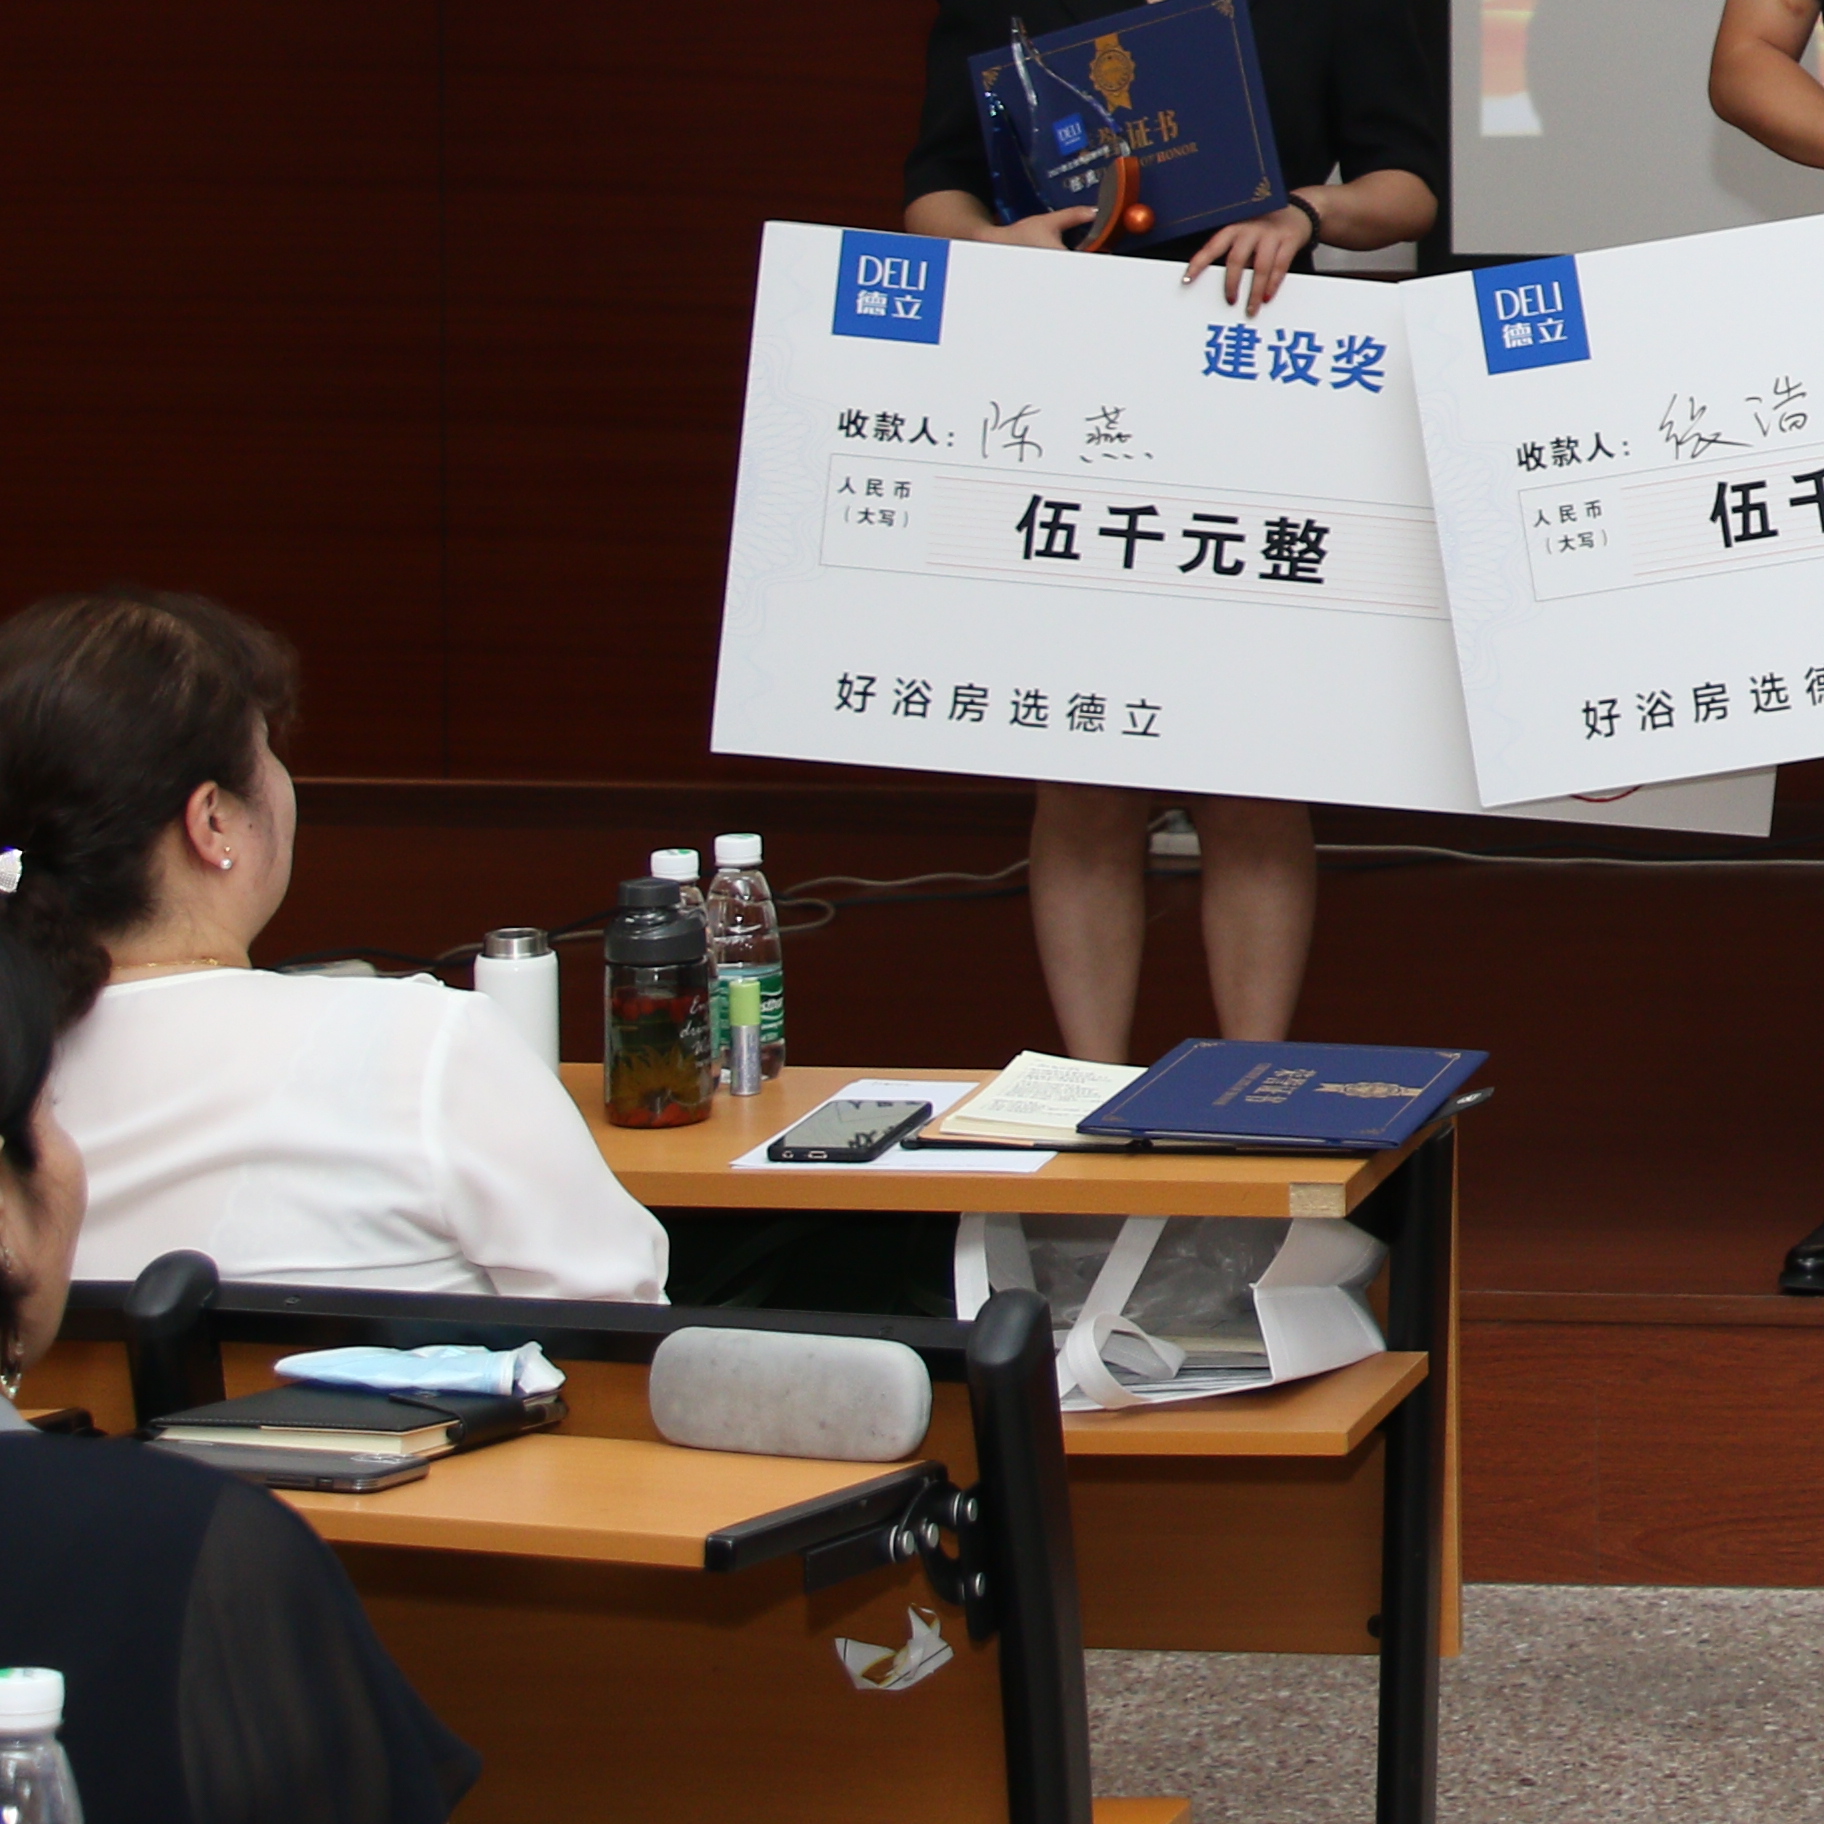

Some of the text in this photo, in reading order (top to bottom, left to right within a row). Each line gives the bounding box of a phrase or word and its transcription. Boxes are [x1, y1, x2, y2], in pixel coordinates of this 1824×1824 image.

[858, 255, 928, 290] DELI
[856, 290, 922, 321] 德立
[1494, 280, 1563, 321] DELI
[1502, 317, 1568, 349] 德立
[1202, 322, 1386, 393] 建设奖
[838, 478, 912, 500] 人民币
[1533, 500, 1604, 528] 人民币
[1016, 493, 1330, 585] 伍千元整
[835, 673, 1163, 738] 好浴房选德立
